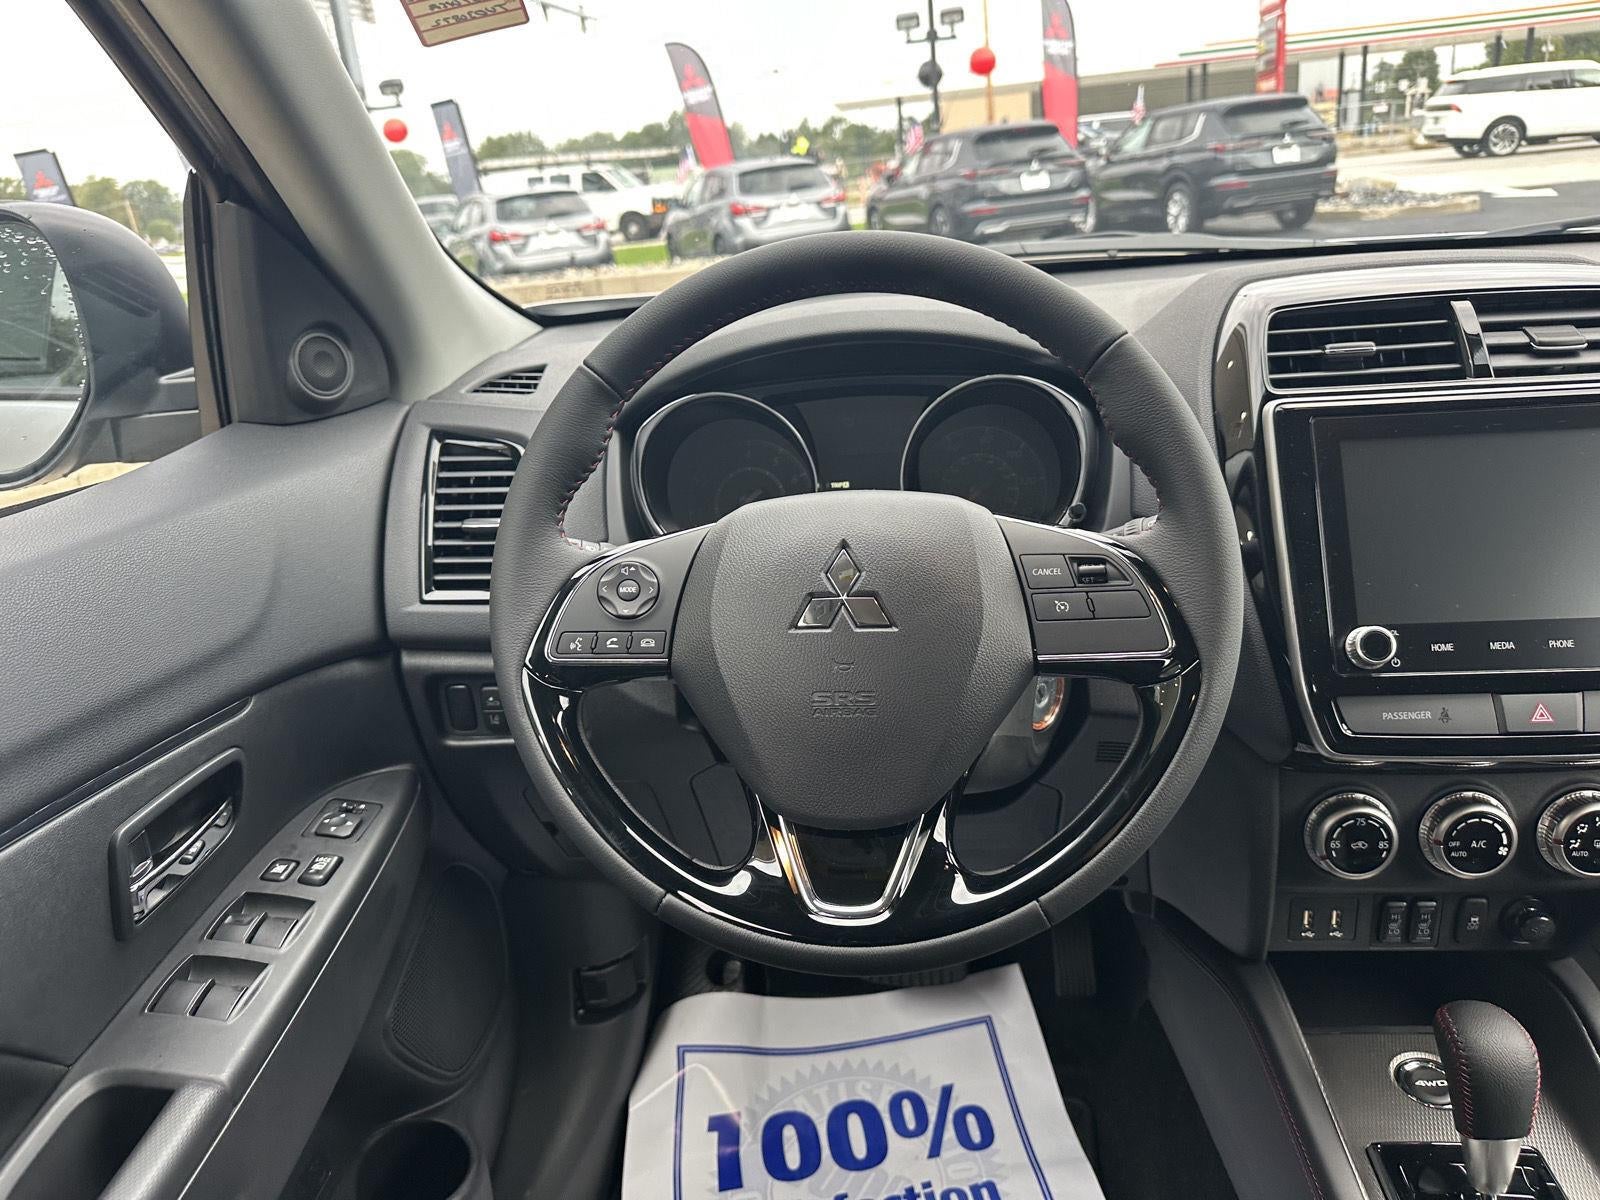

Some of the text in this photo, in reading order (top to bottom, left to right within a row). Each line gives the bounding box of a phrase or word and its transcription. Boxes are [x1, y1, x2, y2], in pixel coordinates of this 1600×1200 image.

[1032, 567, 1061, 576] CANCEL
[1431, 643, 1454, 652] HOME
[1490, 641, 1515, 650] MEDIA
[1549, 639, 1574, 648] PHONE
[811, 691, 876, 705] SRS
[1382, 710, 1432, 720] PASSENGER
[1356, 818, 1366, 826] 75
[1330, 841, 1340, 849] 65
[1378, 841, 1389, 849] 85
[1471, 840, 1487, 848] A/C
[708, 1083, 995, 1192] 100%
